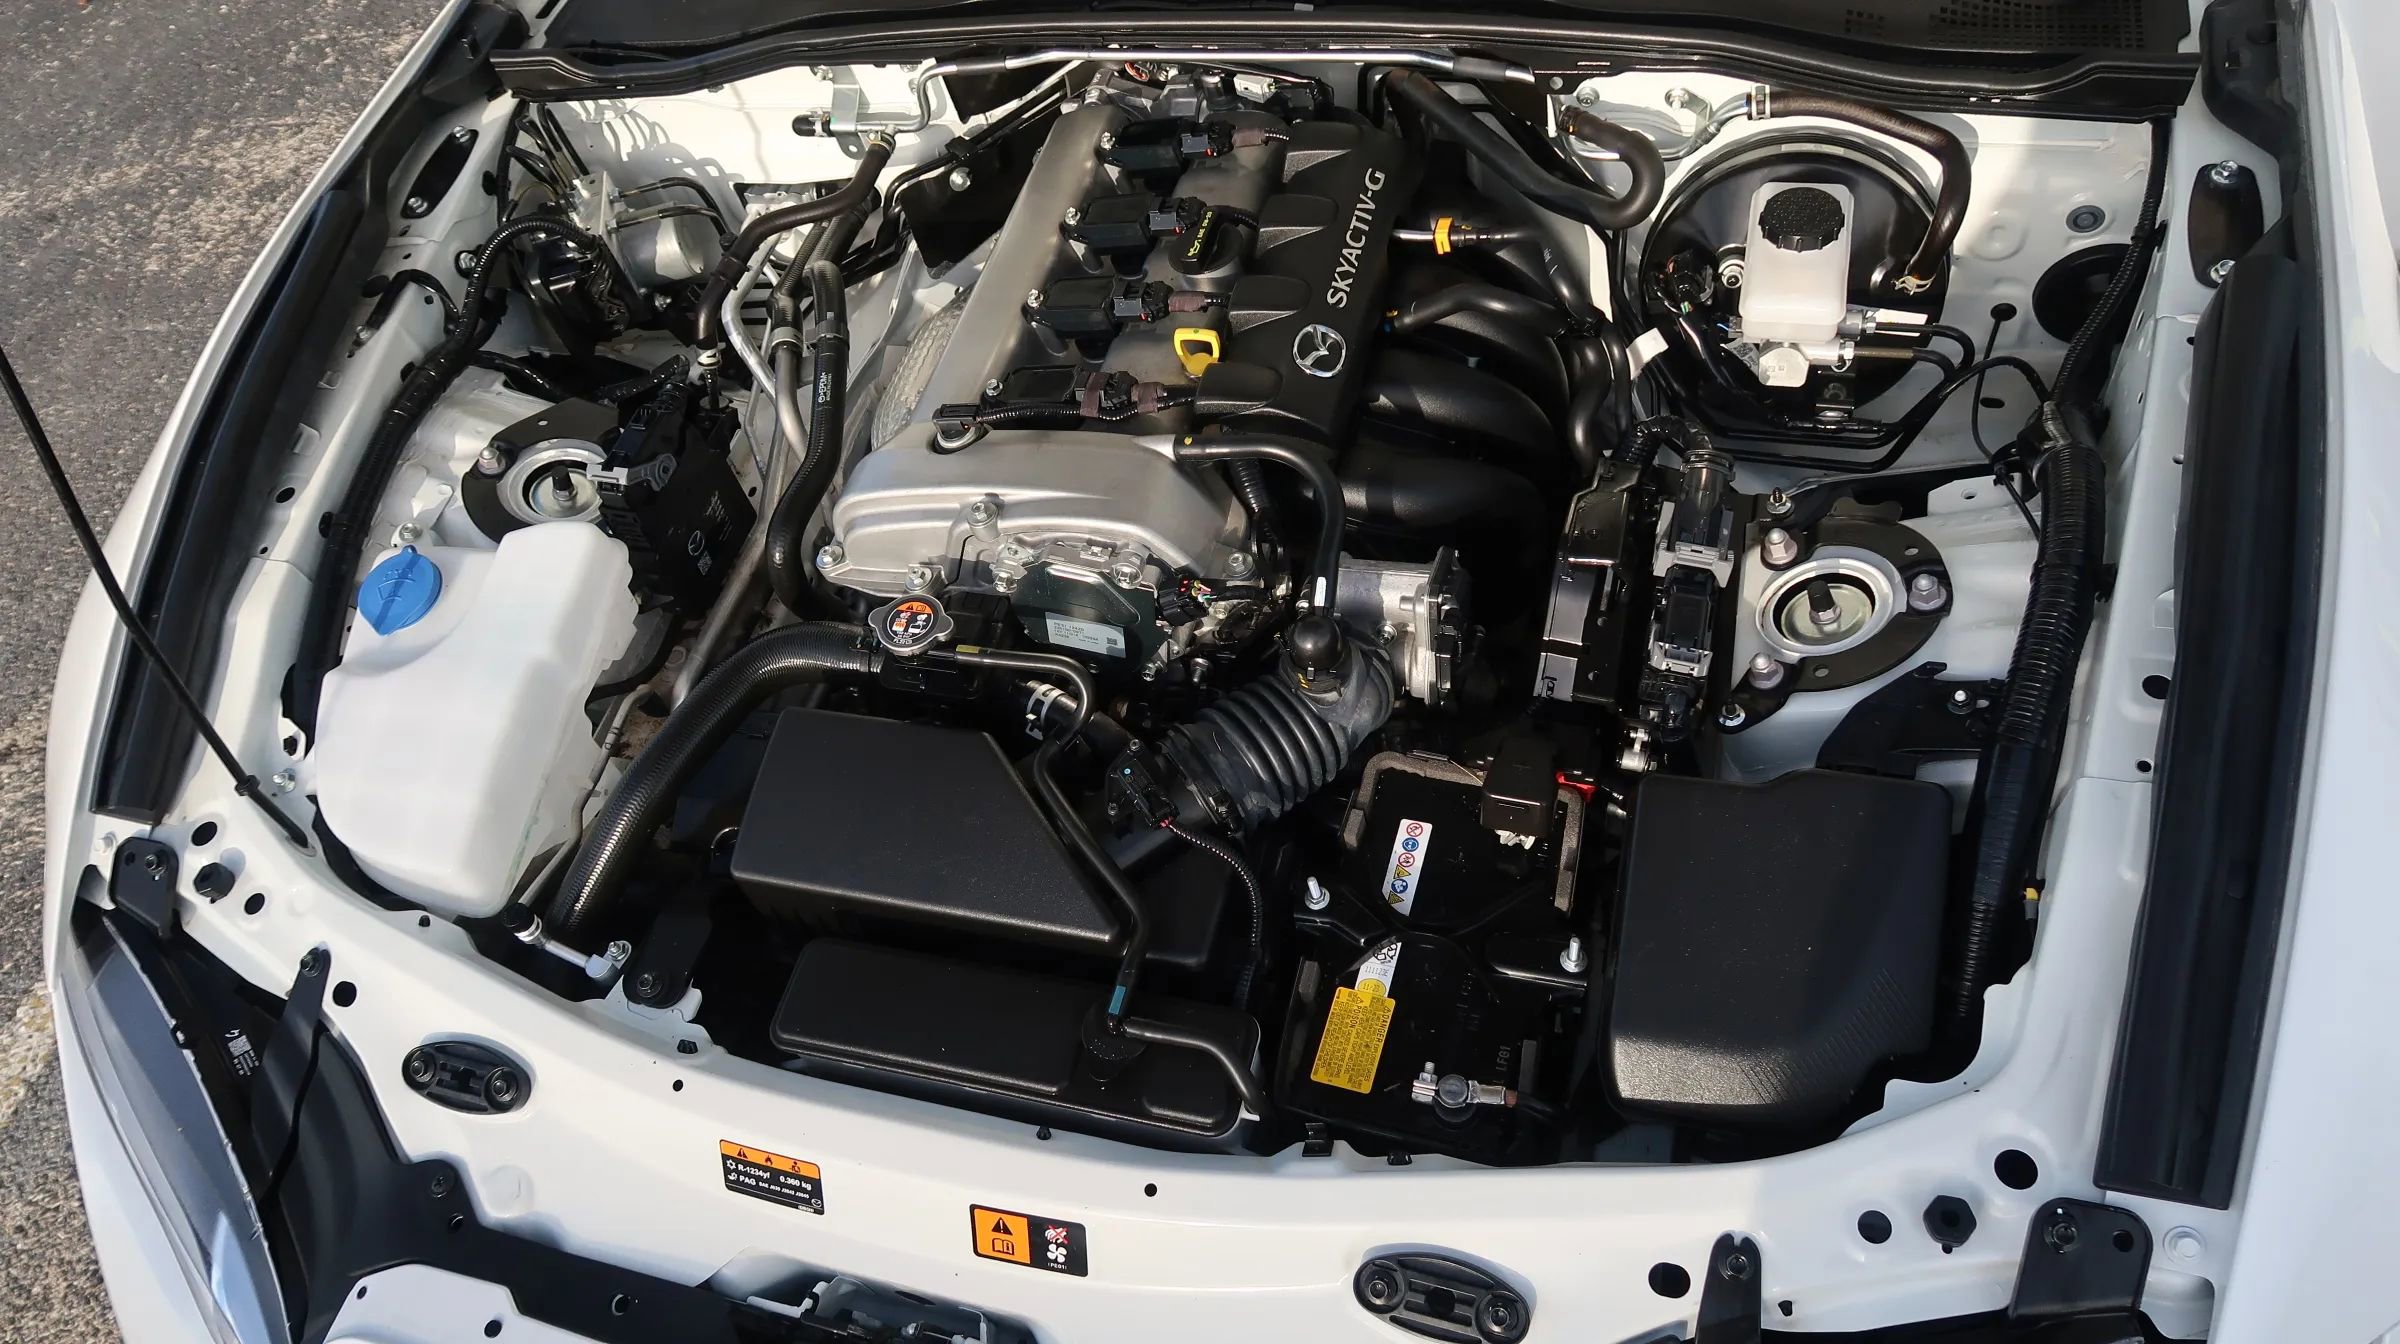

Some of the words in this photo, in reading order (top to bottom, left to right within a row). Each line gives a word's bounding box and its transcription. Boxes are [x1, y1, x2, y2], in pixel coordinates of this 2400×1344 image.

[1326, 167, 1386, 308] SKYACTIV-G
[1348, 1004, 1361, 1028] POISON
[1374, 1013, 1389, 1043] DANGER
[738, 1164, 770, 1179] R-1234yf
[802, 1181, 812, 1191] kg
[739, 1175, 756, 1186] PAG
